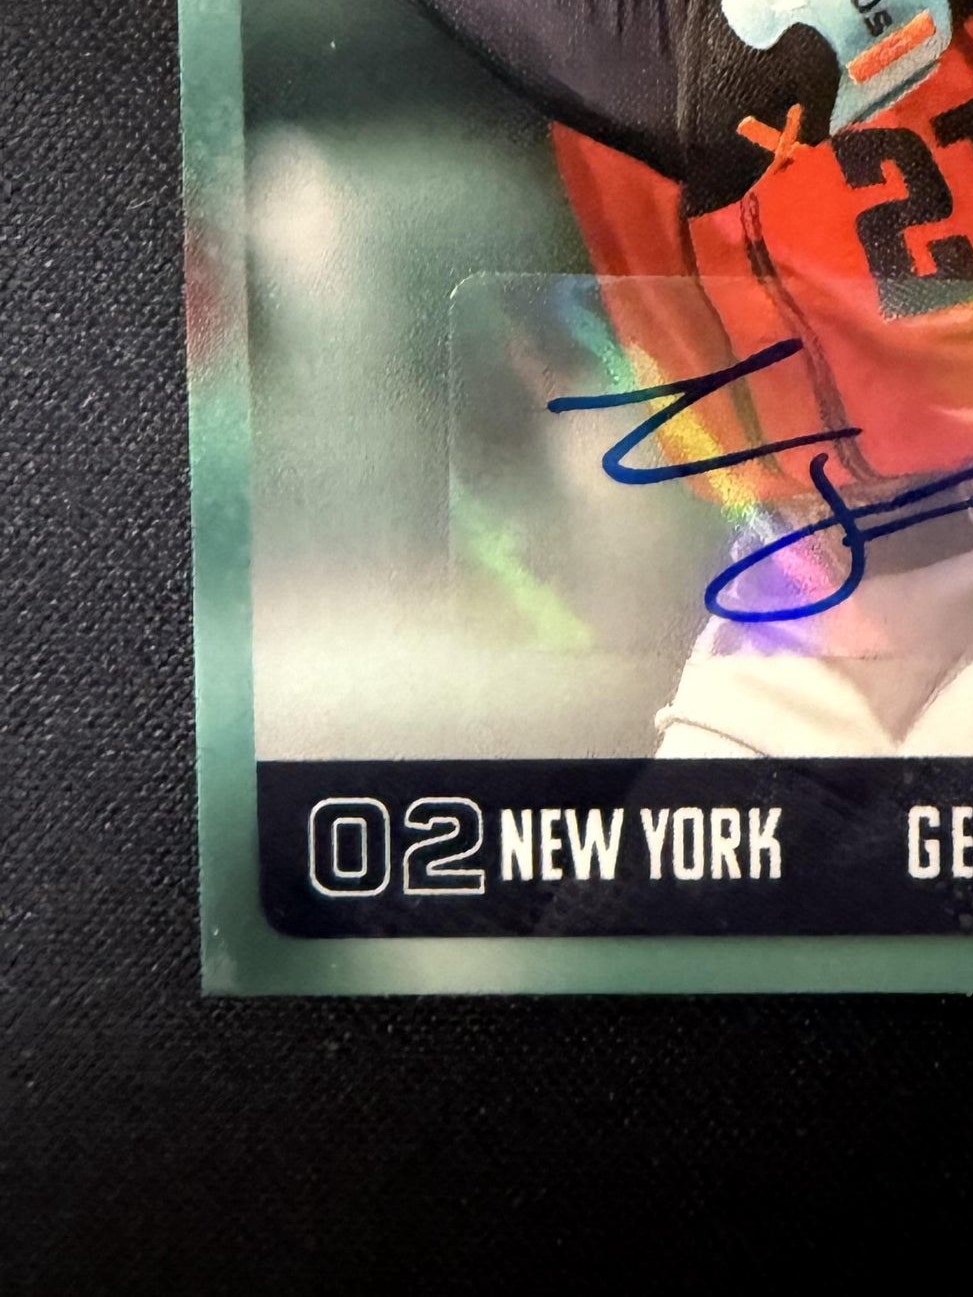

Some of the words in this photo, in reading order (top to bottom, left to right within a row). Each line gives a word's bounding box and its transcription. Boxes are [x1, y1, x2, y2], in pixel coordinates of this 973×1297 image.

[308, 796, 486, 897] 02
[500, 808, 624, 881] NEW
[640, 807, 783, 880] YORK
